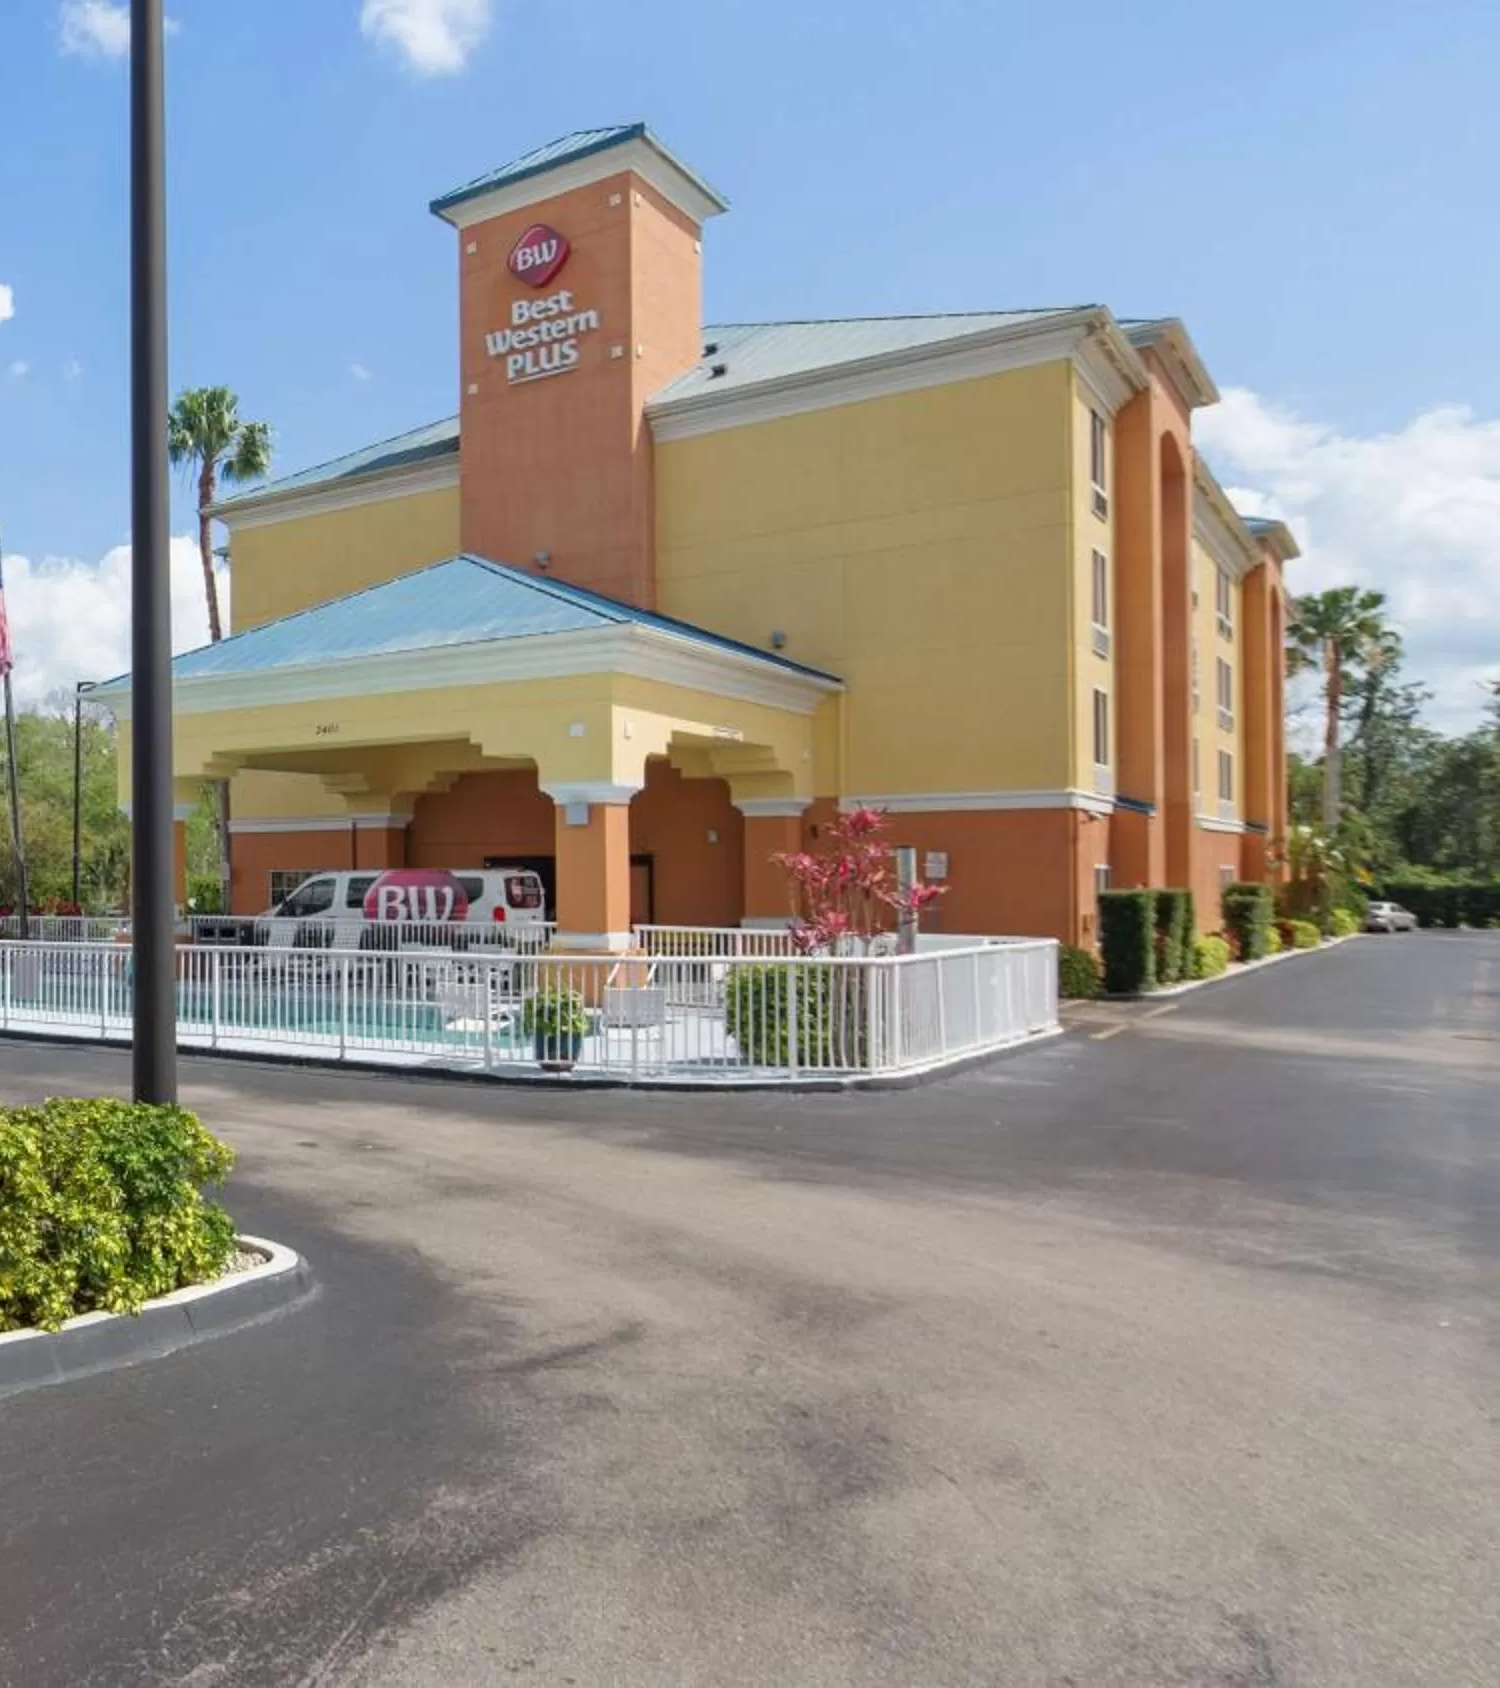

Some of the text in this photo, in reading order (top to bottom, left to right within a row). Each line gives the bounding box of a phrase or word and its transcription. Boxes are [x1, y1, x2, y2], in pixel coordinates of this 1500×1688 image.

[516, 239, 557, 272] BW
[511, 289, 574, 325] Best
[485, 309, 599, 357] Western
[507, 338, 580, 379] PLUS
[376, 885, 454, 921] BW
